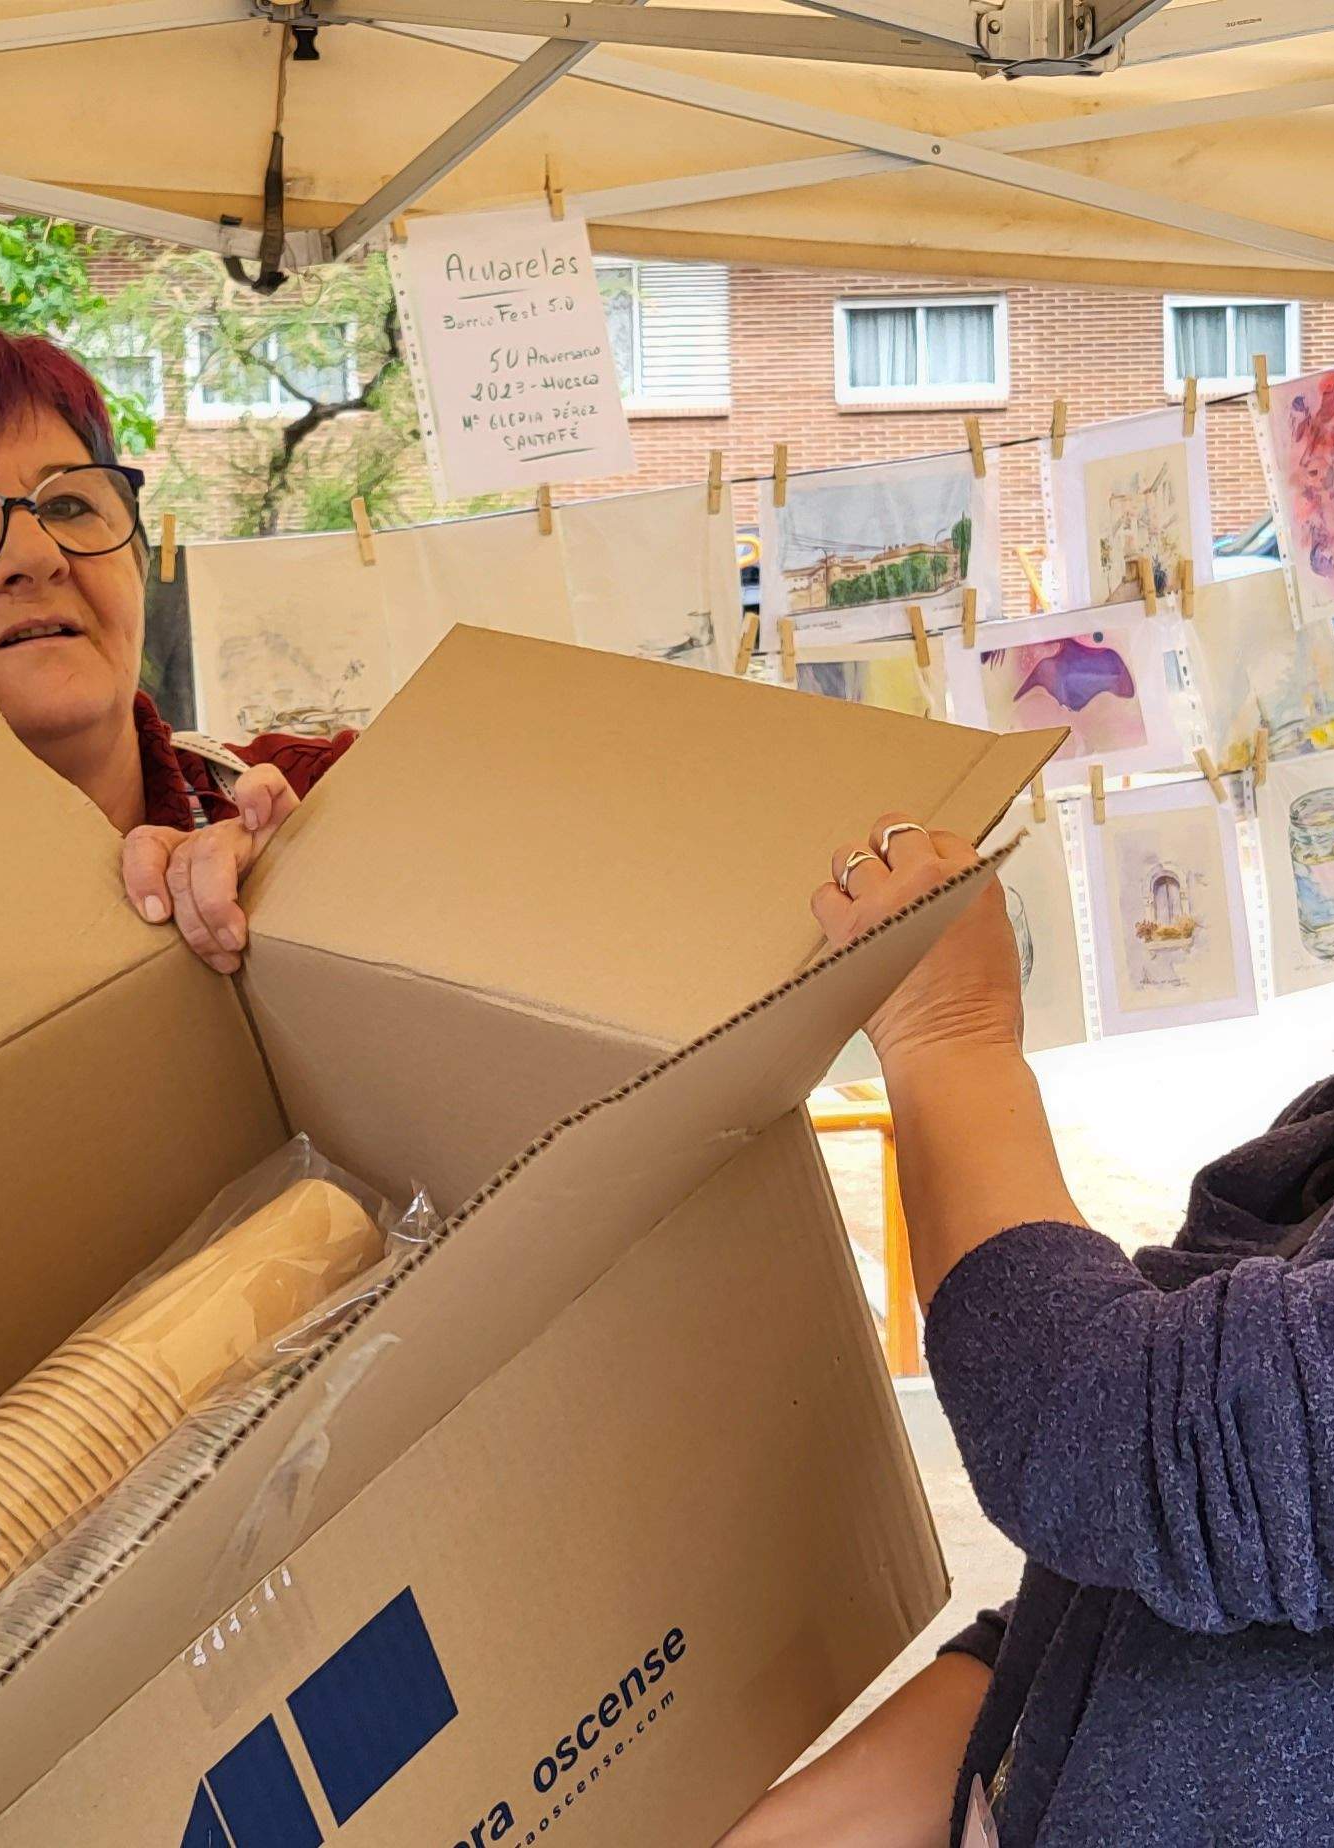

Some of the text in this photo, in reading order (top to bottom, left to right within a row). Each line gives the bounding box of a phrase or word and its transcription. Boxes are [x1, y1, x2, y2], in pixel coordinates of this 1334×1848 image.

[445, 249, 579, 283] Acuarelas
[493, 302, 538, 322] Fest
[548, 297, 574, 312] 5.0
[450, 1627, 686, 1848] ra oscense
